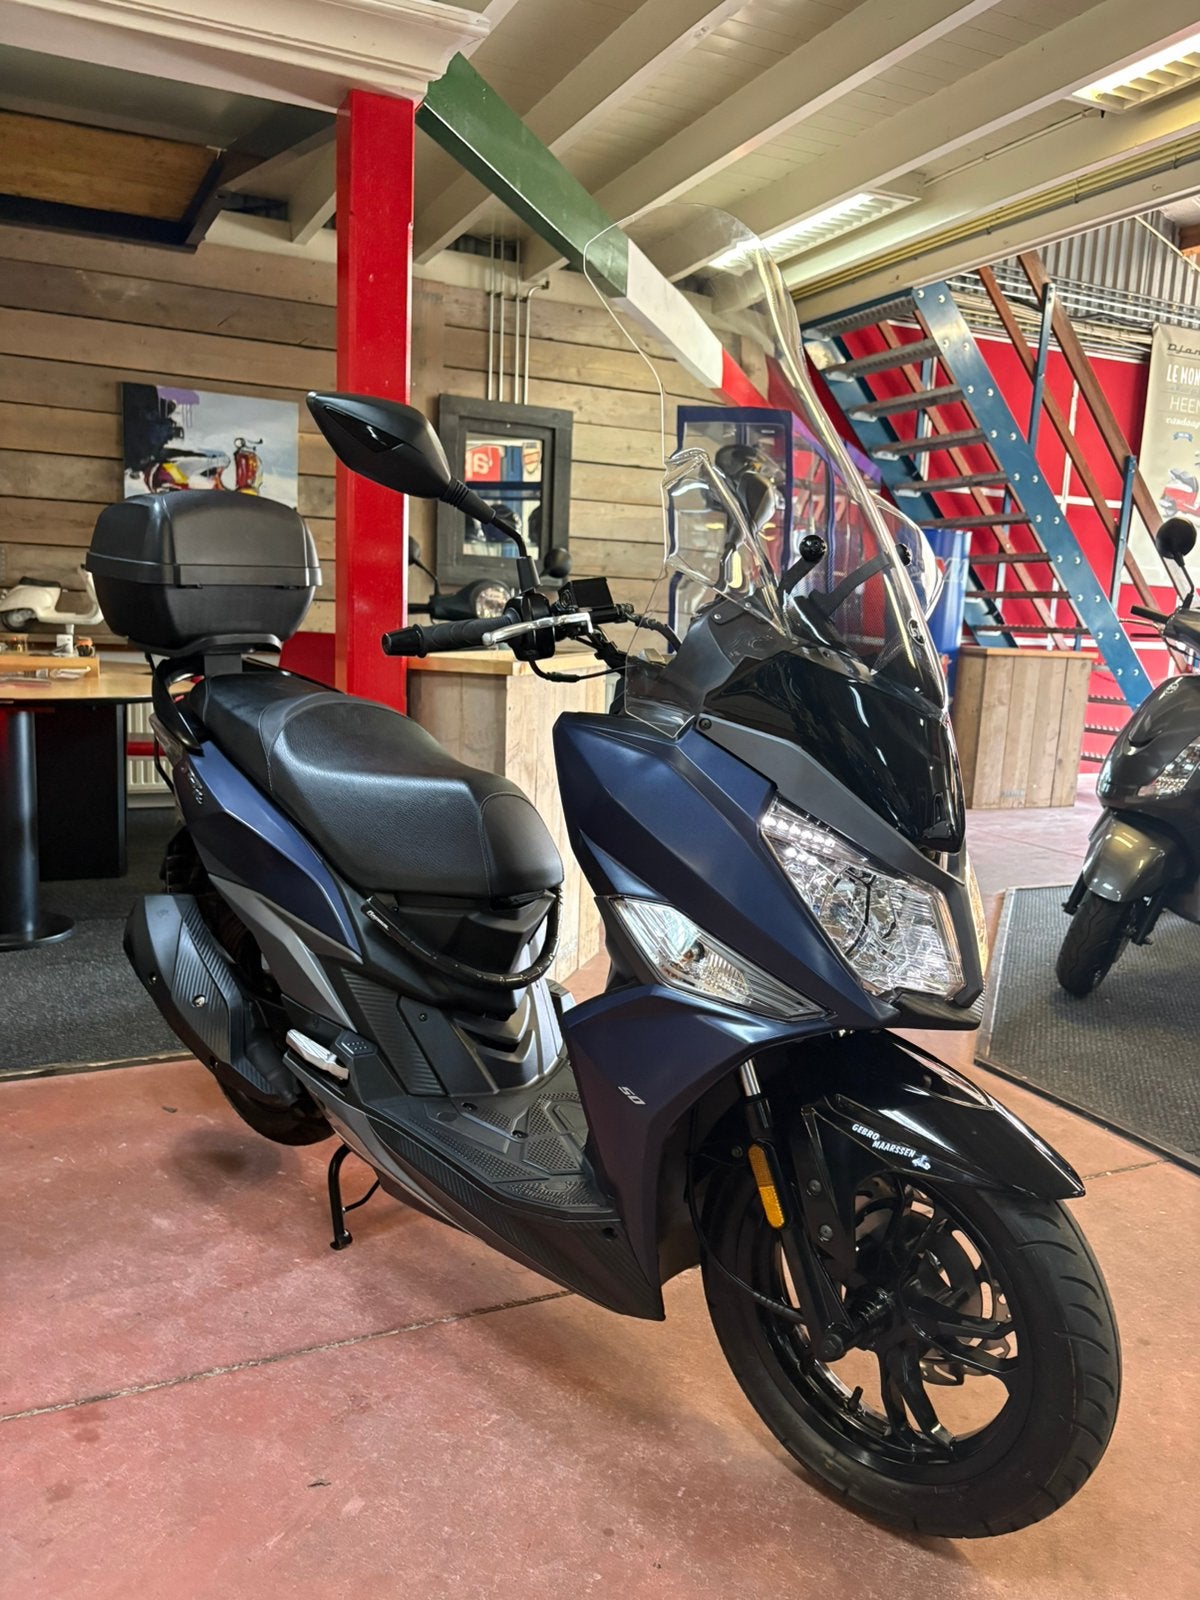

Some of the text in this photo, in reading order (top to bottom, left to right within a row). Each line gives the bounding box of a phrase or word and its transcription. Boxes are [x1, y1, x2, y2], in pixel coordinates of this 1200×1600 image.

[1167, 363, 1179, 384] LE
[618, 1086, 646, 1105] 50
[852, 1123, 880, 1141] GEBRO
[871, 1140, 917, 1158] MAARSSEN
